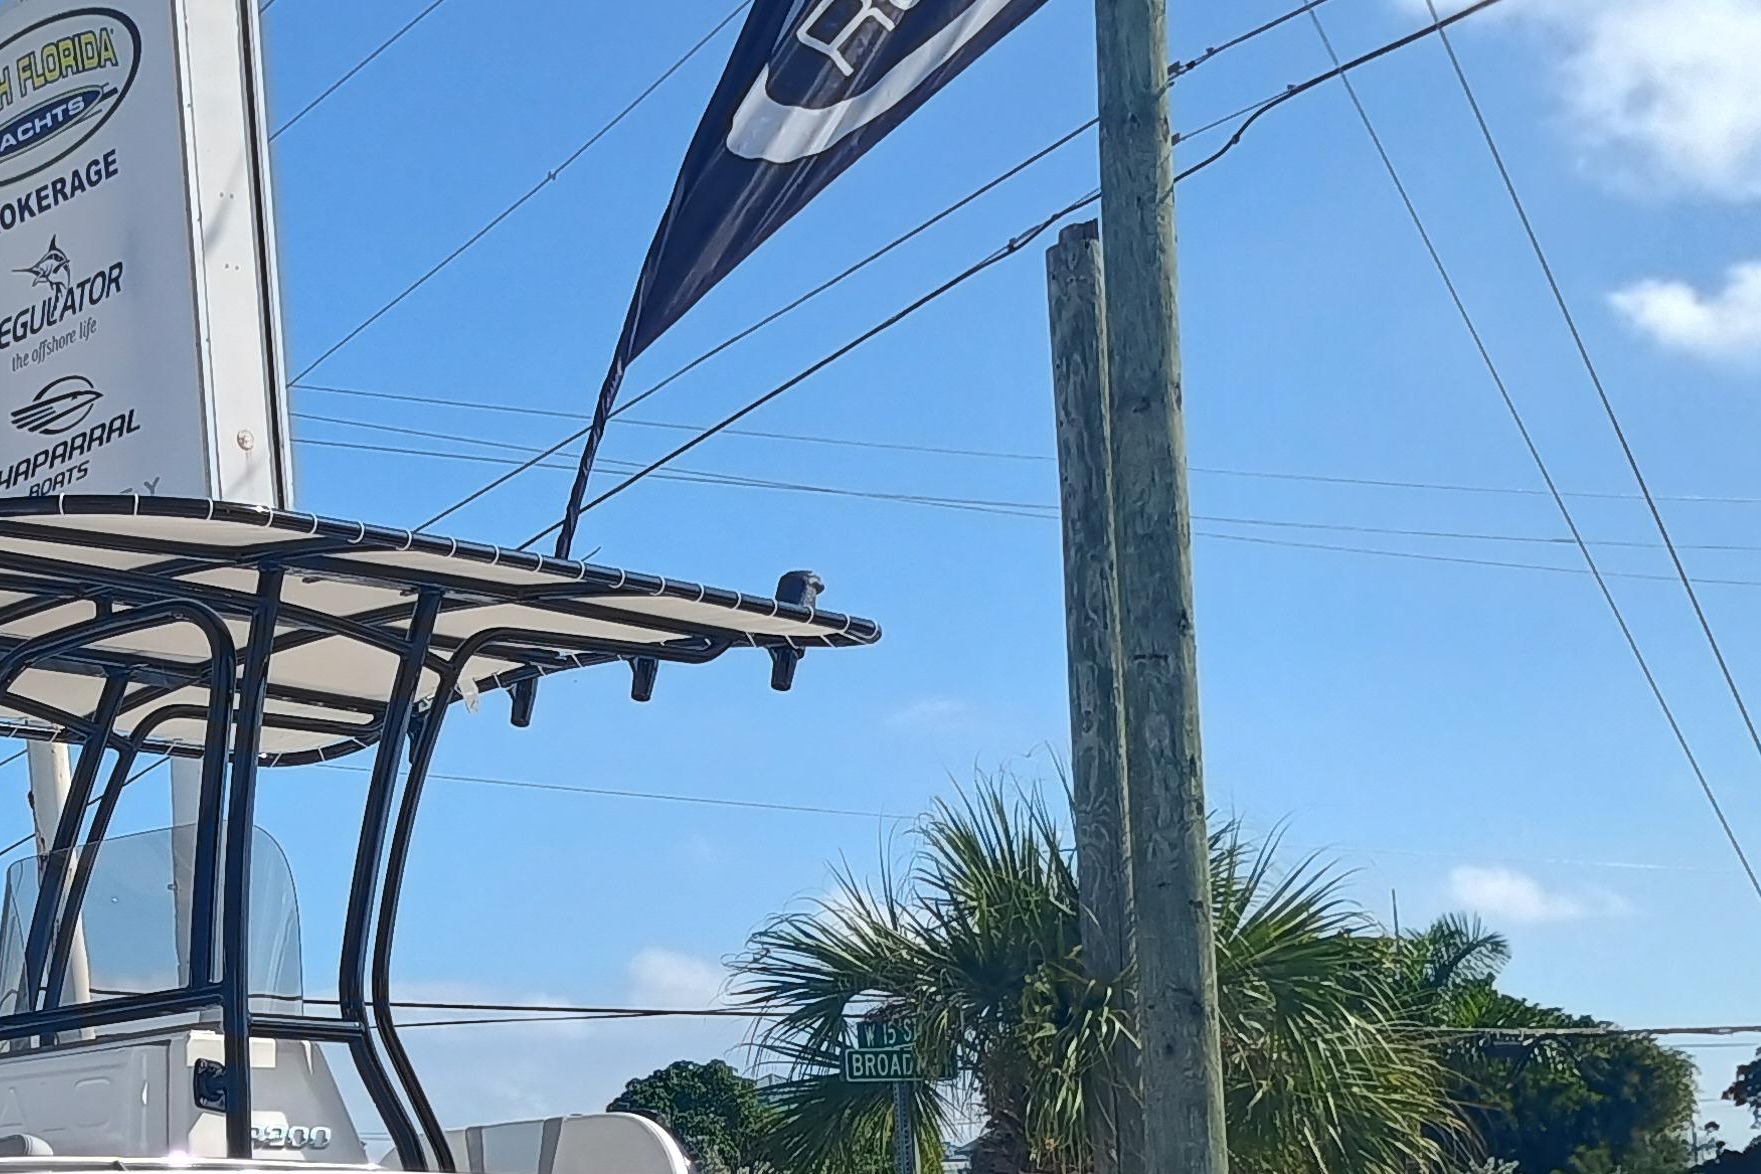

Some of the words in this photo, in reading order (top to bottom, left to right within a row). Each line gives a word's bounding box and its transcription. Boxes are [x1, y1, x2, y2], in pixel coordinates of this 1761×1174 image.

[16, 27, 118, 98] FLORIDA
[11, 352, 29, 373] the
[31, 327, 77, 366] offshore
[79, 316, 97, 342] life
[29, 459, 90, 497] BOATS
